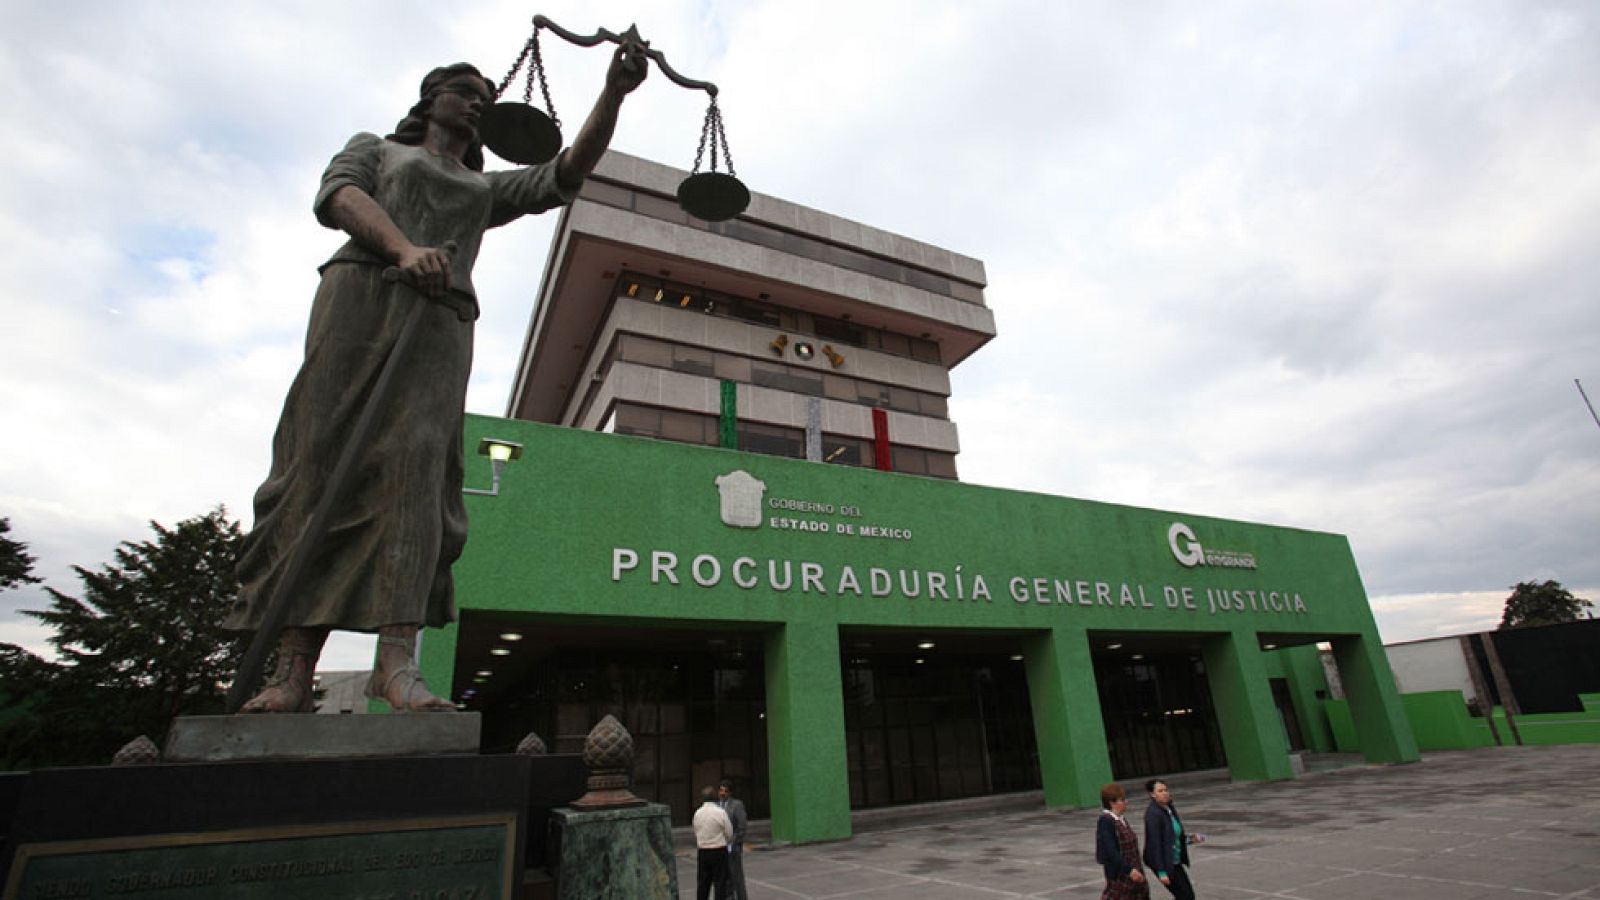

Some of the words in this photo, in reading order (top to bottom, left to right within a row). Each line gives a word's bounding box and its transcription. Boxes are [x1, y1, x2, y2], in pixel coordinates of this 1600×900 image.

[768, 497, 835, 514] GOBIERNO
[840, 504, 863, 517] DEL
[769, 517, 830, 533] ESTADO
[836, 523, 855, 535] DE
[859, 525, 912, 540] MEXICO
[611, 548, 993, 602] PROCURADURÍA
[1009, 576, 1154, 609] GENERAL
[1163, 585, 1198, 610] DE
[1206, 587, 1308, 615] JUSTICIA
